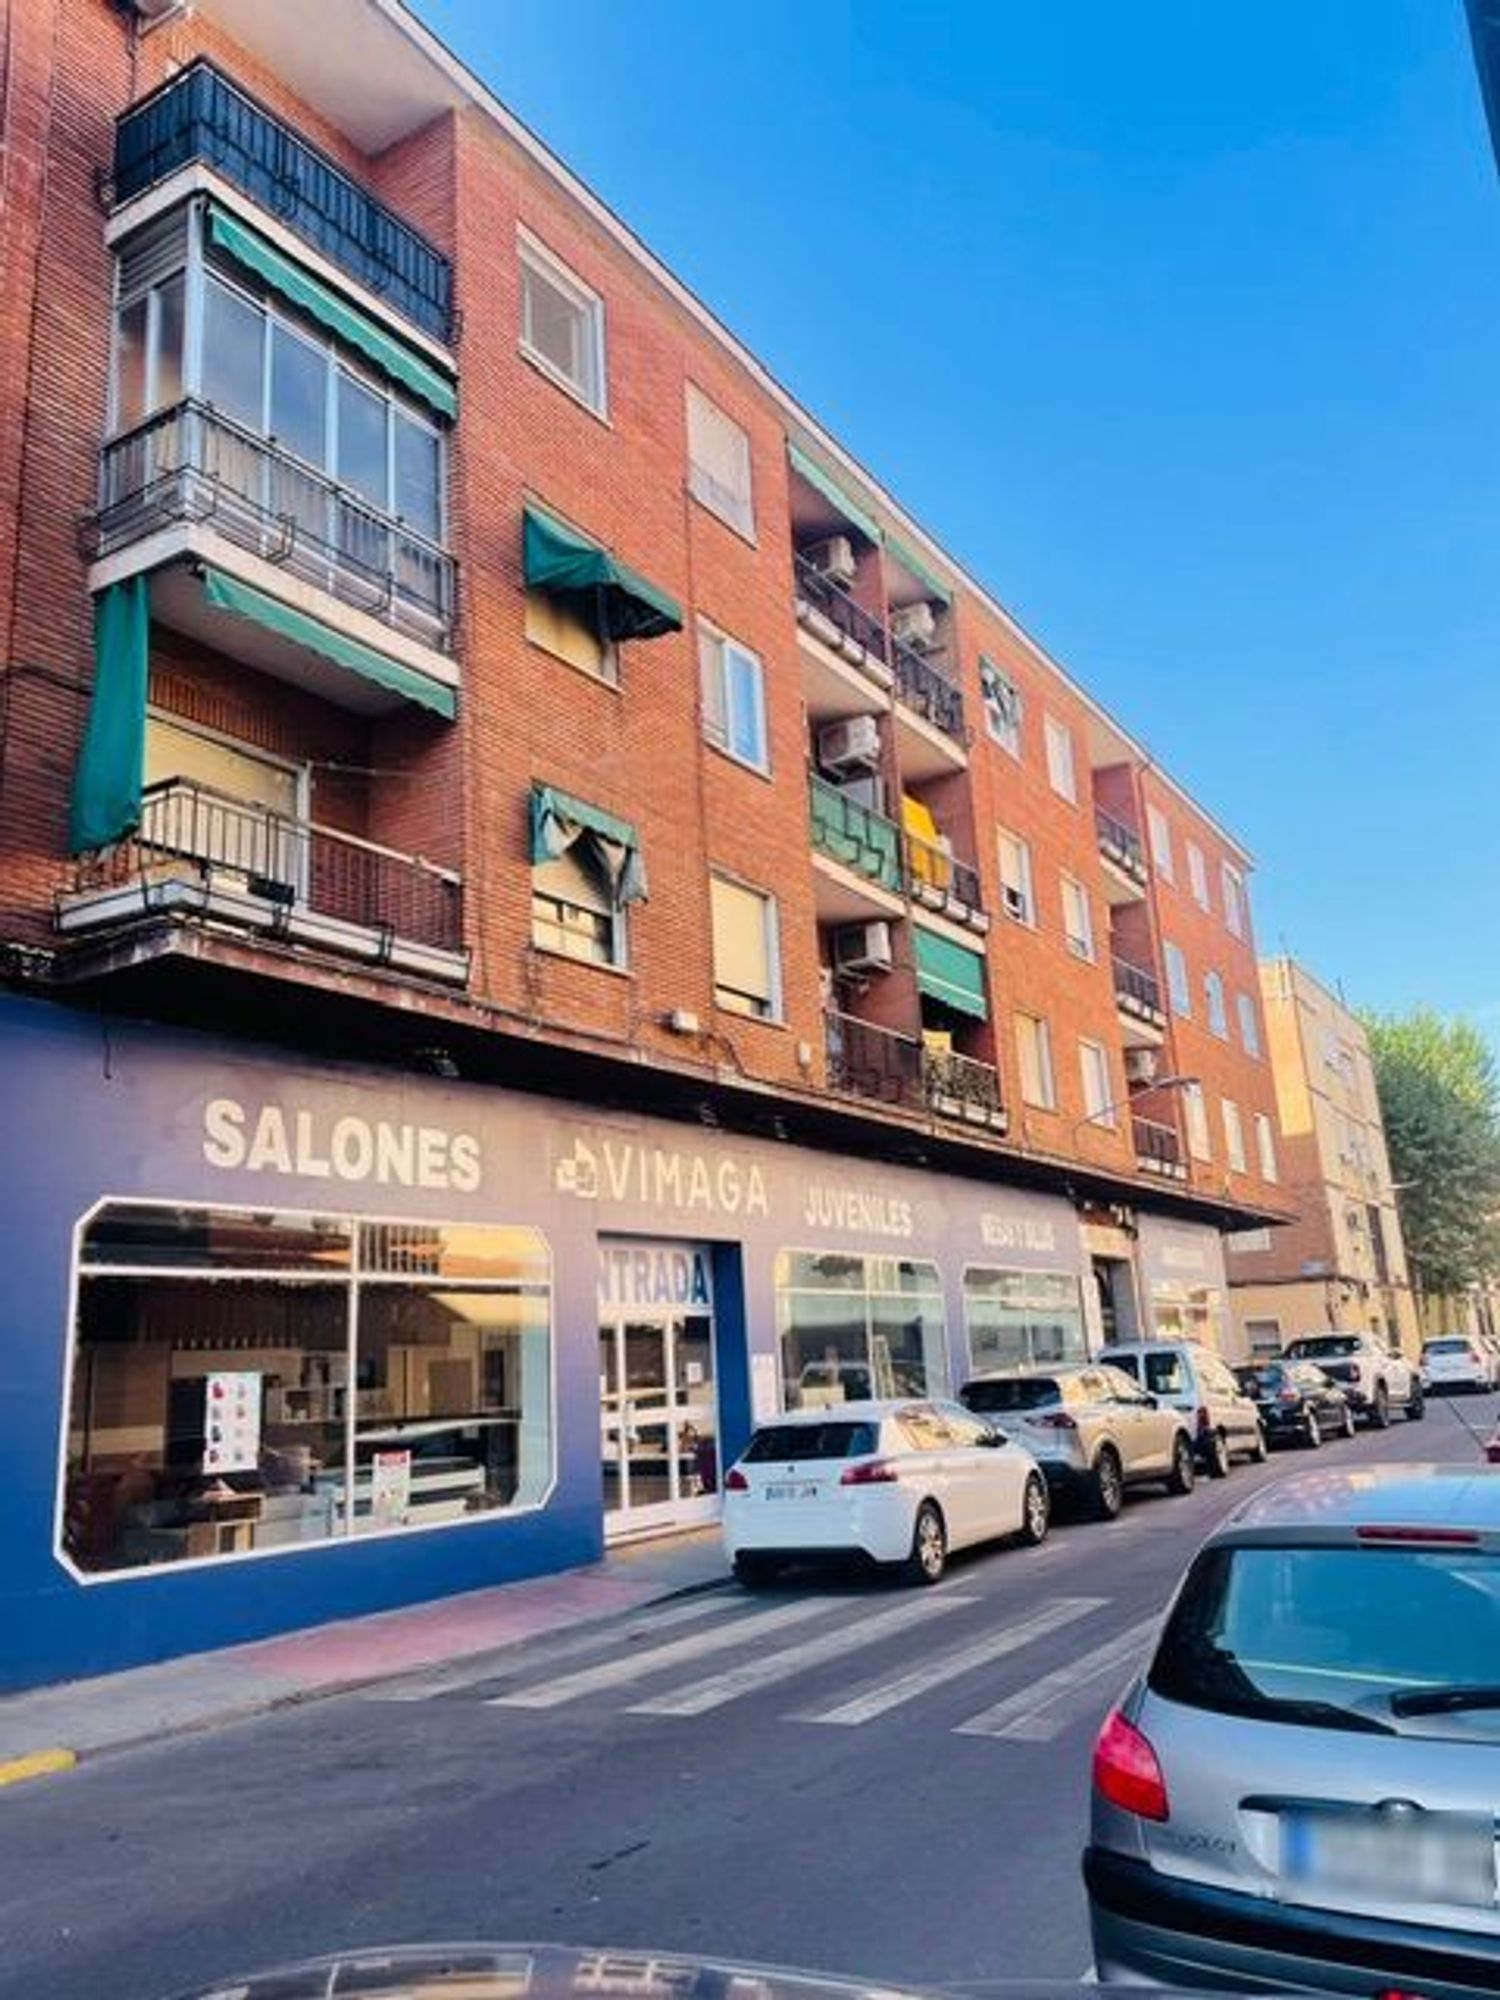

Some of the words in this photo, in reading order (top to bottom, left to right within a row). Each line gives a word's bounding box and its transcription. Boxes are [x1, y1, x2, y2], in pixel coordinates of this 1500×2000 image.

[203, 1099, 480, 1192] SALONES
[603, 1140, 769, 1217] VIMAGA
[804, 1186, 913, 1238] JUVENILES
